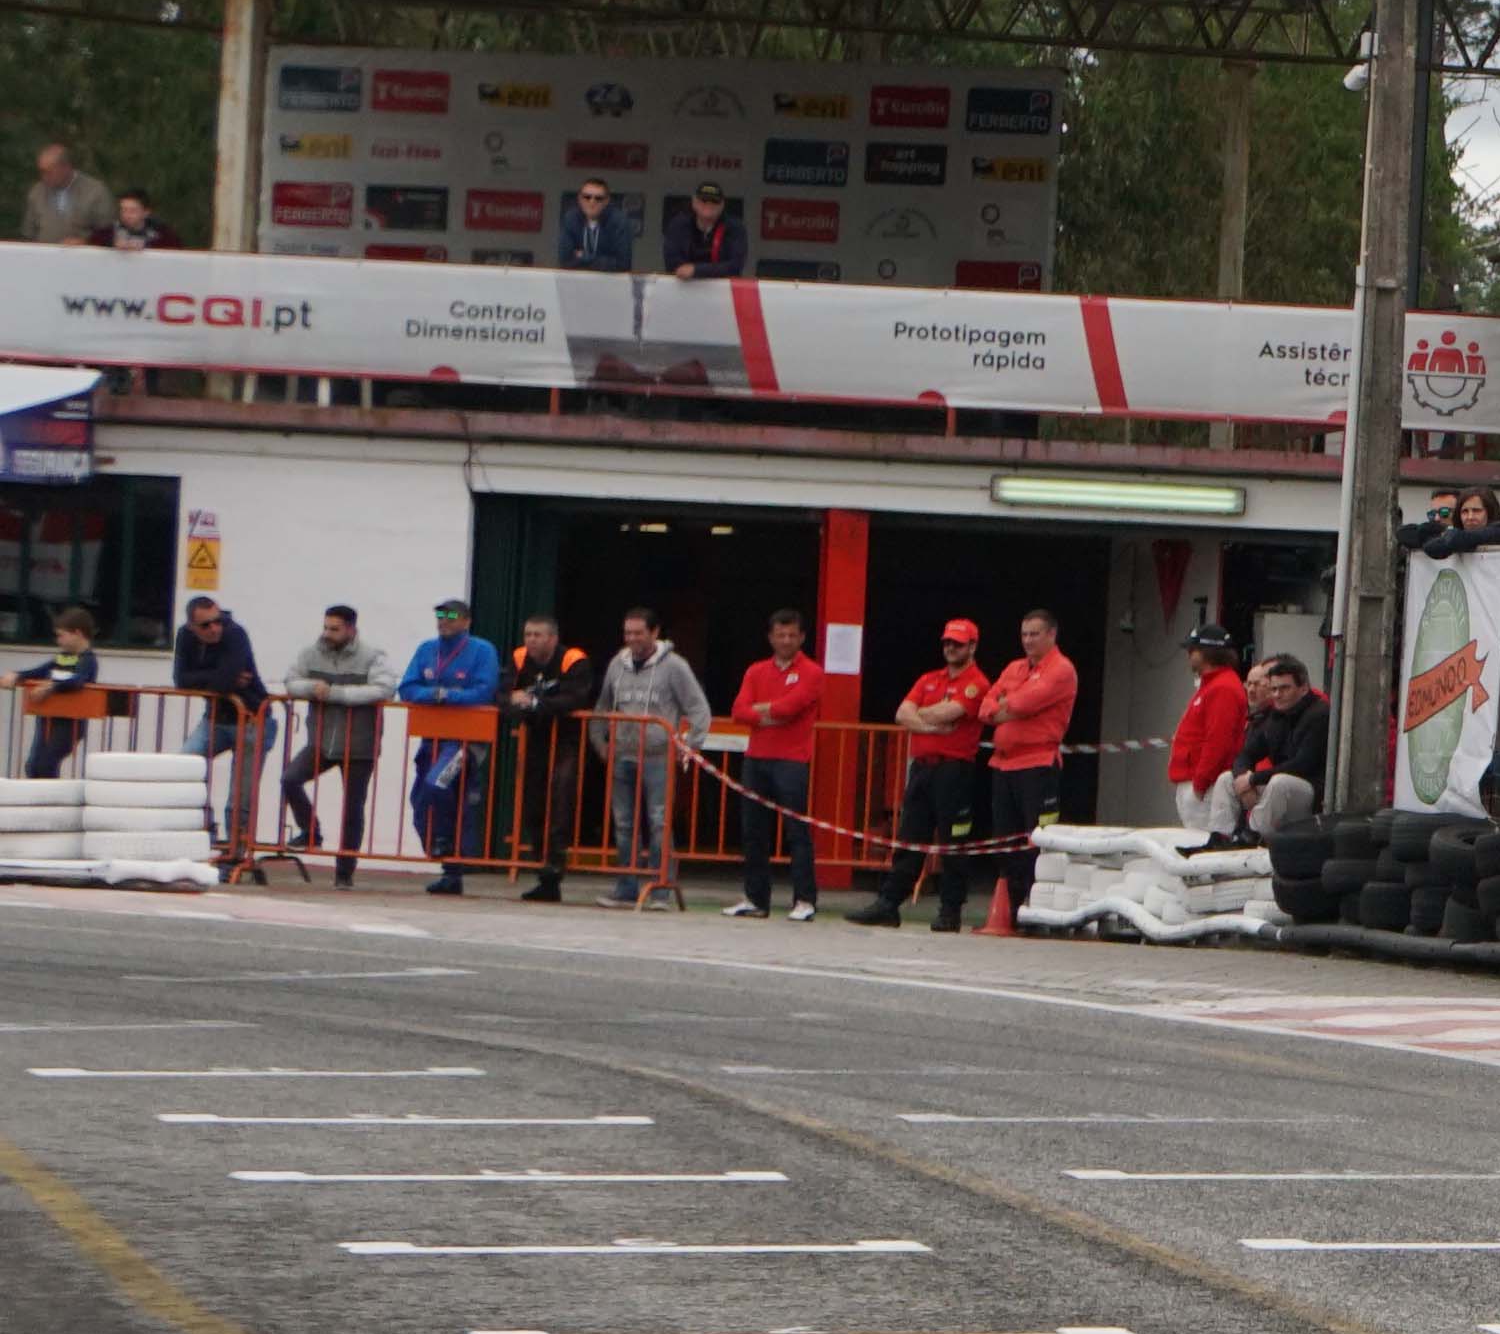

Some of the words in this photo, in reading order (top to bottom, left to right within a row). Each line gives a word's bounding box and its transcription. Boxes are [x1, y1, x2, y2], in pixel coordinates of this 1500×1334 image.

[62, 292, 315, 333] www.CQI.pt
[449, 301, 547, 322] Controlo
[405, 318, 547, 343] Dimensional
[894, 321, 1047, 347] Prototipagem
[973, 348, 1046, 372] rápida
